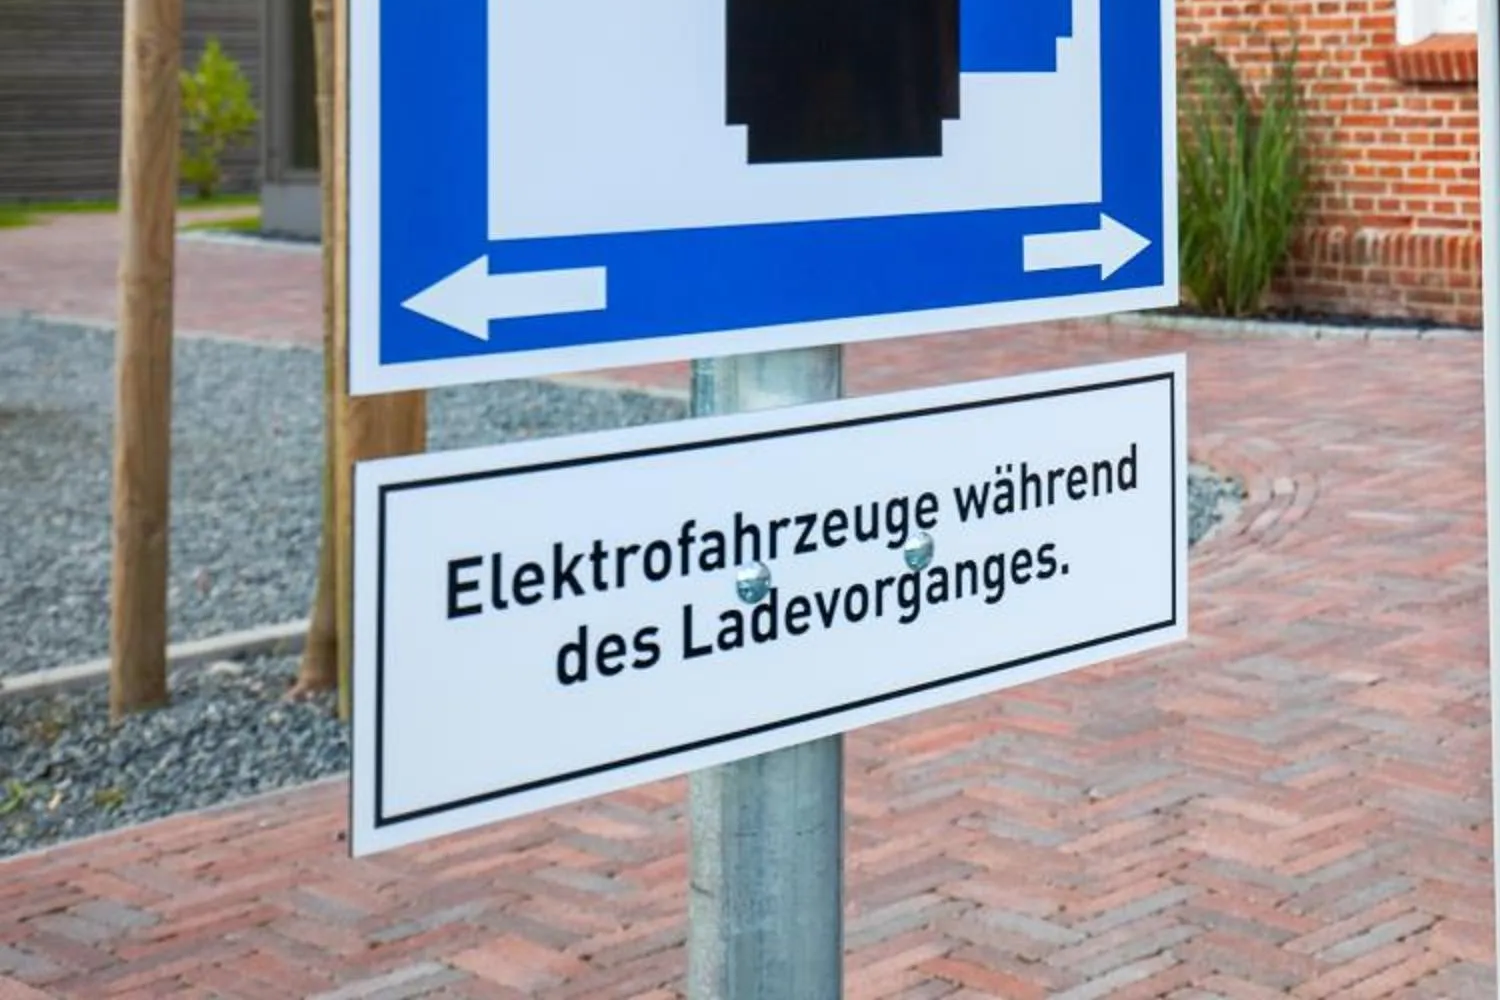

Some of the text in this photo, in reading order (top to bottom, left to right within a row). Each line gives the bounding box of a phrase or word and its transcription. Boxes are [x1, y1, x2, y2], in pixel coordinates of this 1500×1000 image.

[447, 443, 1137, 619] Elektrofahrzeuge während
[557, 543, 1069, 686] des Ladevorganges.
